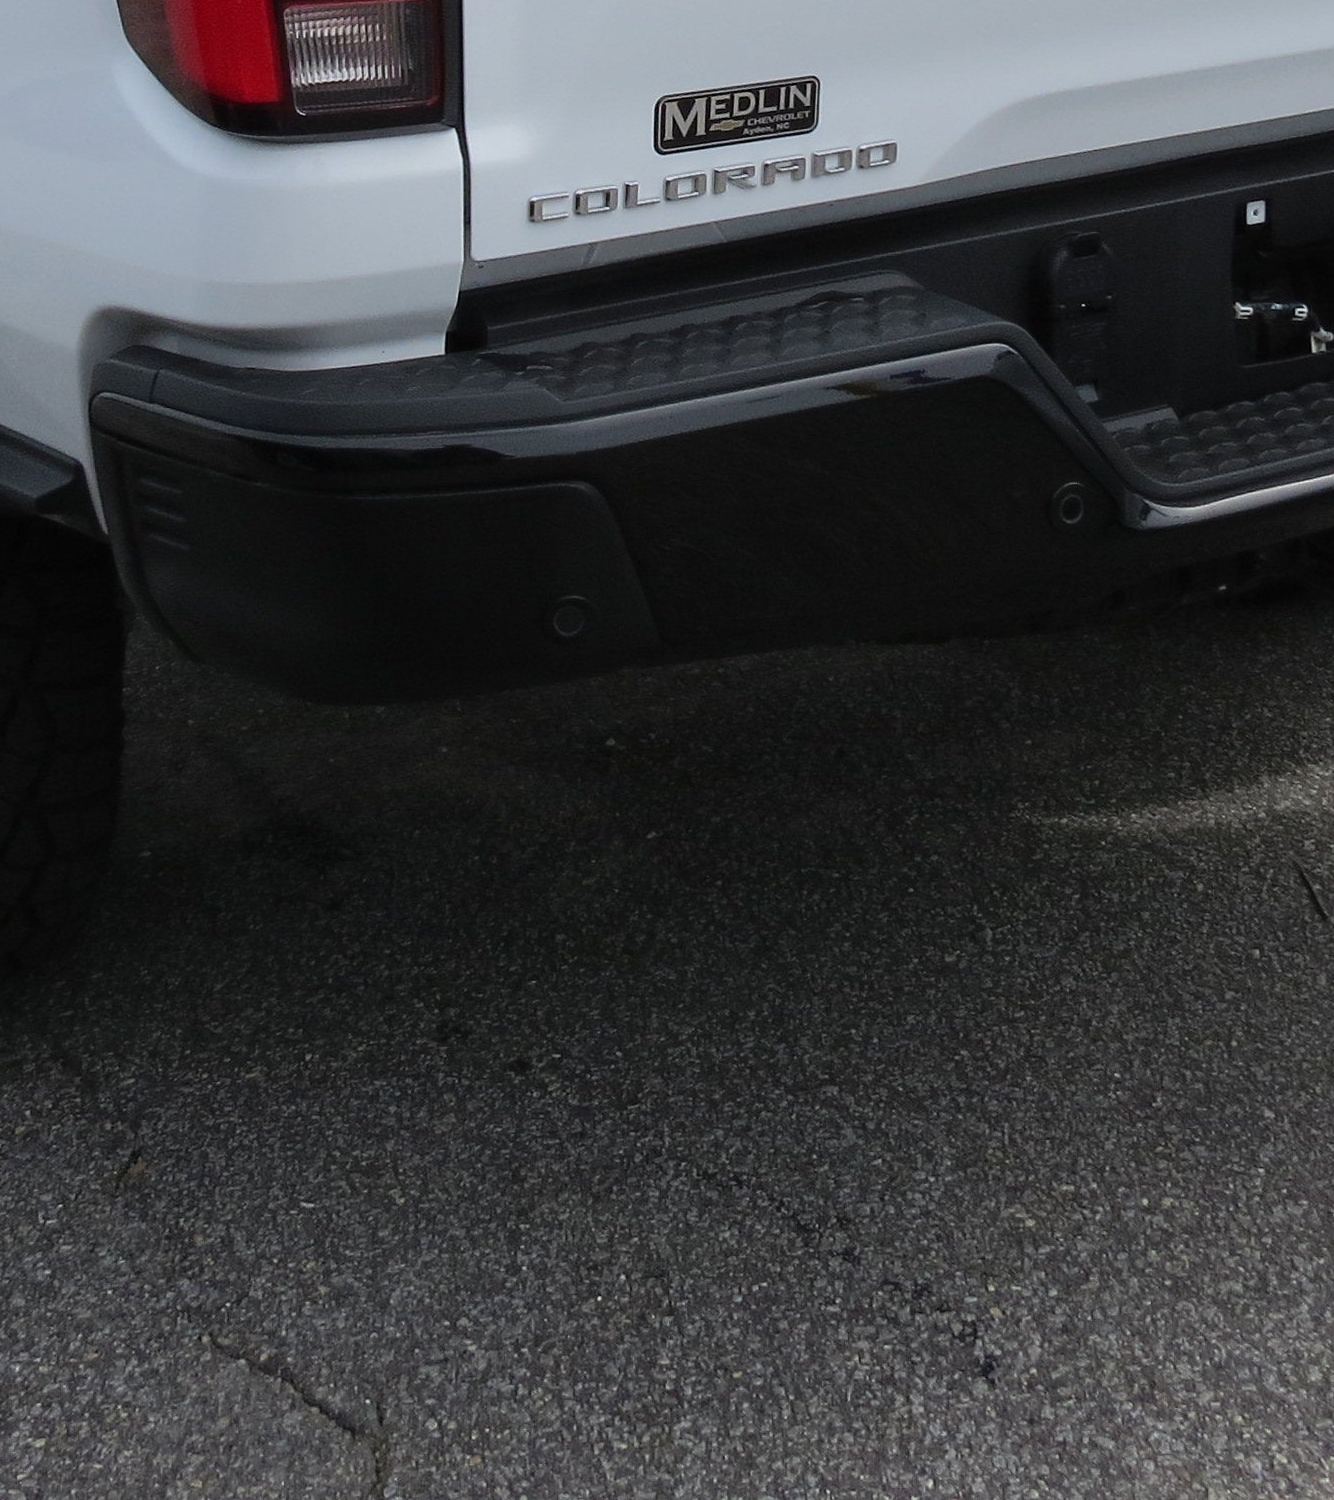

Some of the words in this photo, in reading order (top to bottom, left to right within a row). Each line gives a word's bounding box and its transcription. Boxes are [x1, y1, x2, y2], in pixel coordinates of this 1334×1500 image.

[663, 83, 813, 142] MEDLIN
[747, 110, 811, 126] CHEVROLET
[776, 121, 790, 130] NC
[529, 139, 898, 223] COLORADO
